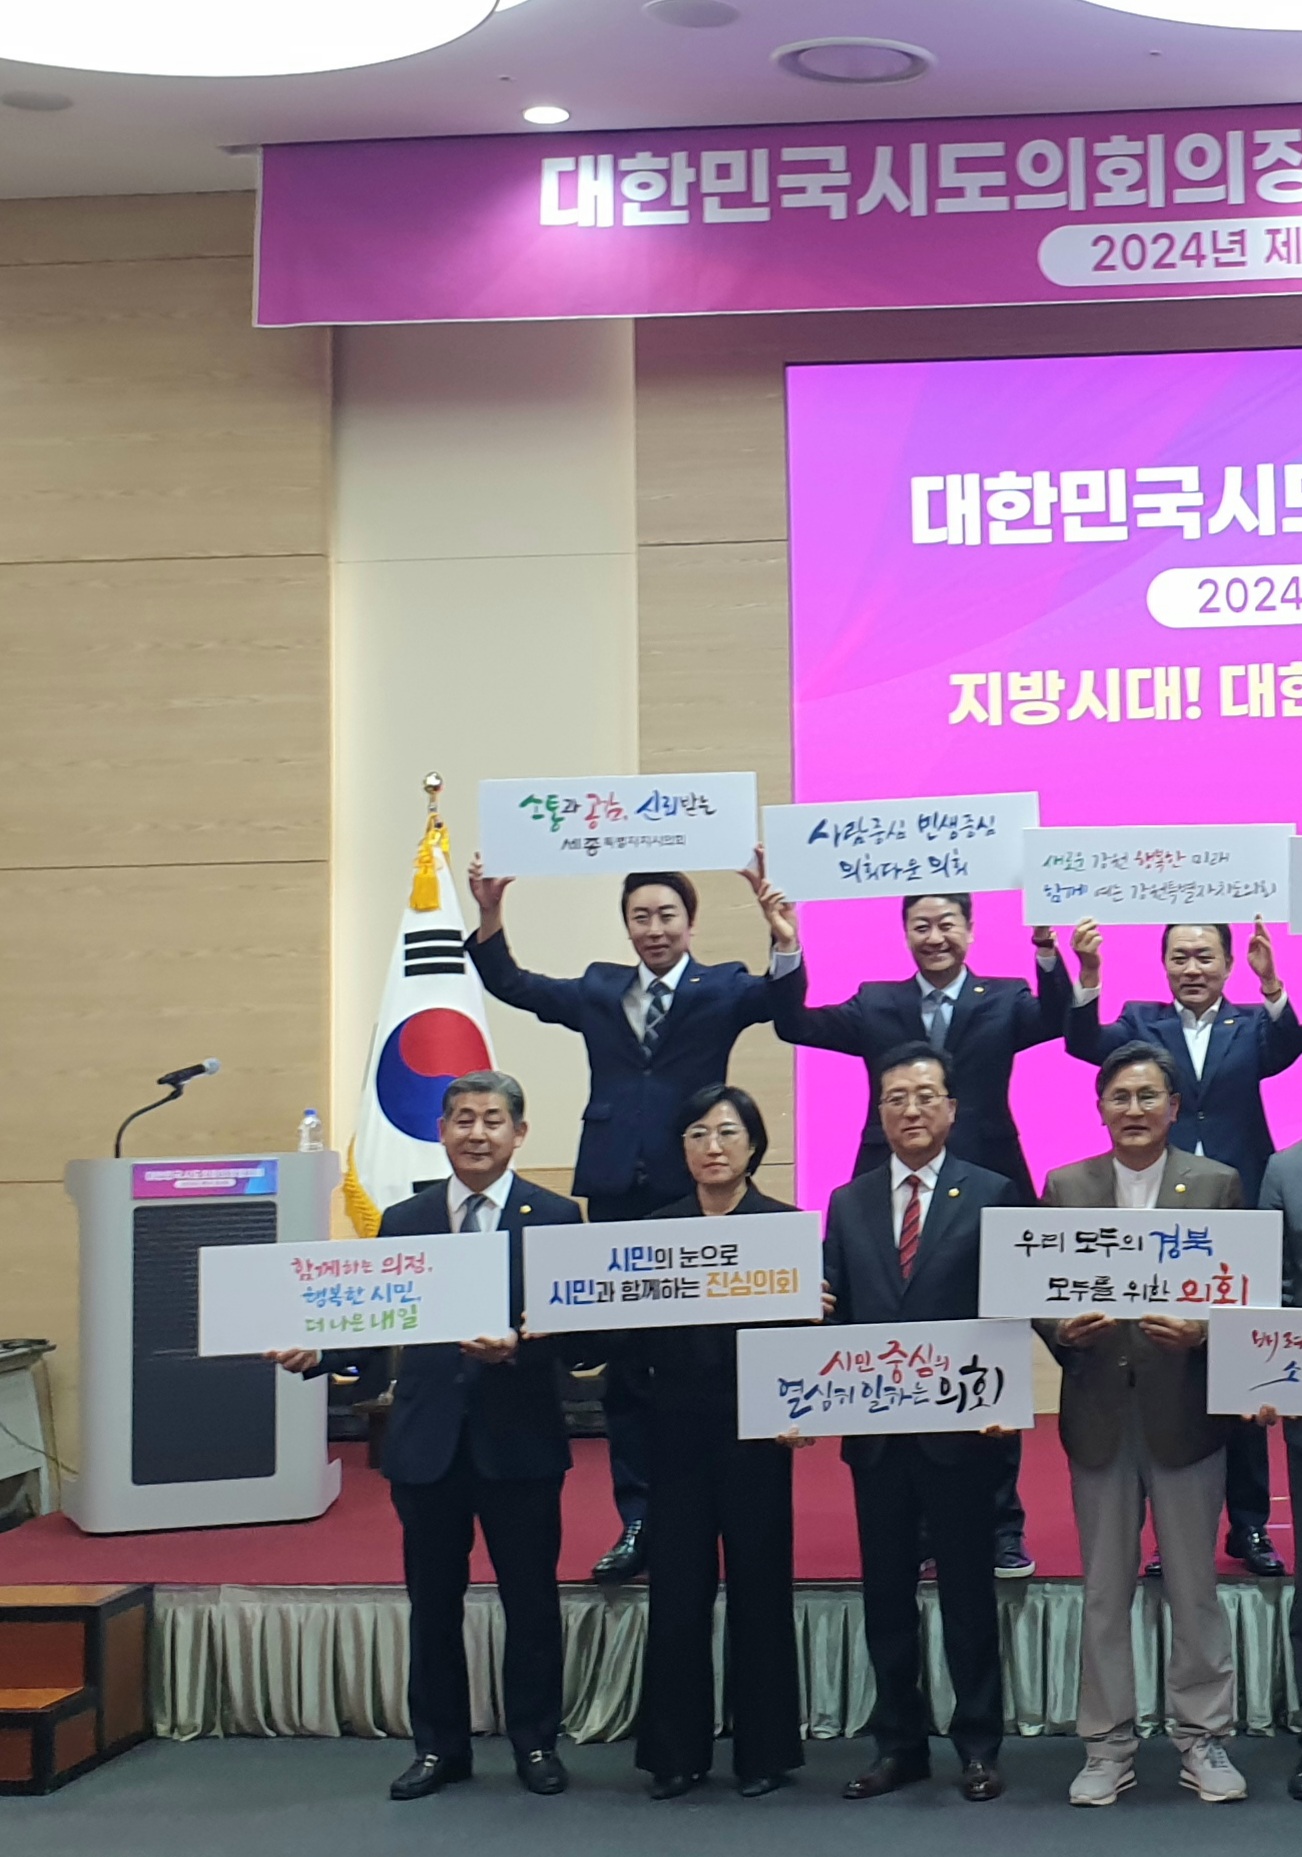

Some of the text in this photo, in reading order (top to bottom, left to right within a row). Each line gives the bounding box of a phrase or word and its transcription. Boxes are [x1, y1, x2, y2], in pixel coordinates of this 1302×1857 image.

[1091, 228, 1247, 272] 2024년
[948, 663, 1202, 726] 지방시대!
[519, 794, 582, 832] 소통과
[635, 789, 717, 821] 신뢰받는
[808, 811, 997, 848] 사람중심 민생중심
[839, 848, 970, 883] 의회다운 의회
[1042, 848, 1231, 873] 새로운 강원 행복한 미래
[1043, 882, 1088, 903] 함께
[1131, 880, 1278, 905] 강원특별자치도의회
[607, 1243, 739, 1272] 시민의 눈으로
[1014, 1224, 1214, 1263] 우리 모두의 경북
[291, 1257, 374, 1281] 함께하는
[550, 1268, 798, 1305] 시민과 함께하는 진심의회
[1046, 1262, 1249, 1305] 모두를 위한 의회
[301, 1283, 365, 1308] 행복한
[305, 1304, 419, 1332] 더 나은 내일
[819, 1340, 950, 1383] 시민 중심의
[778, 1354, 1004, 1418] 열심히 일하는 의회
